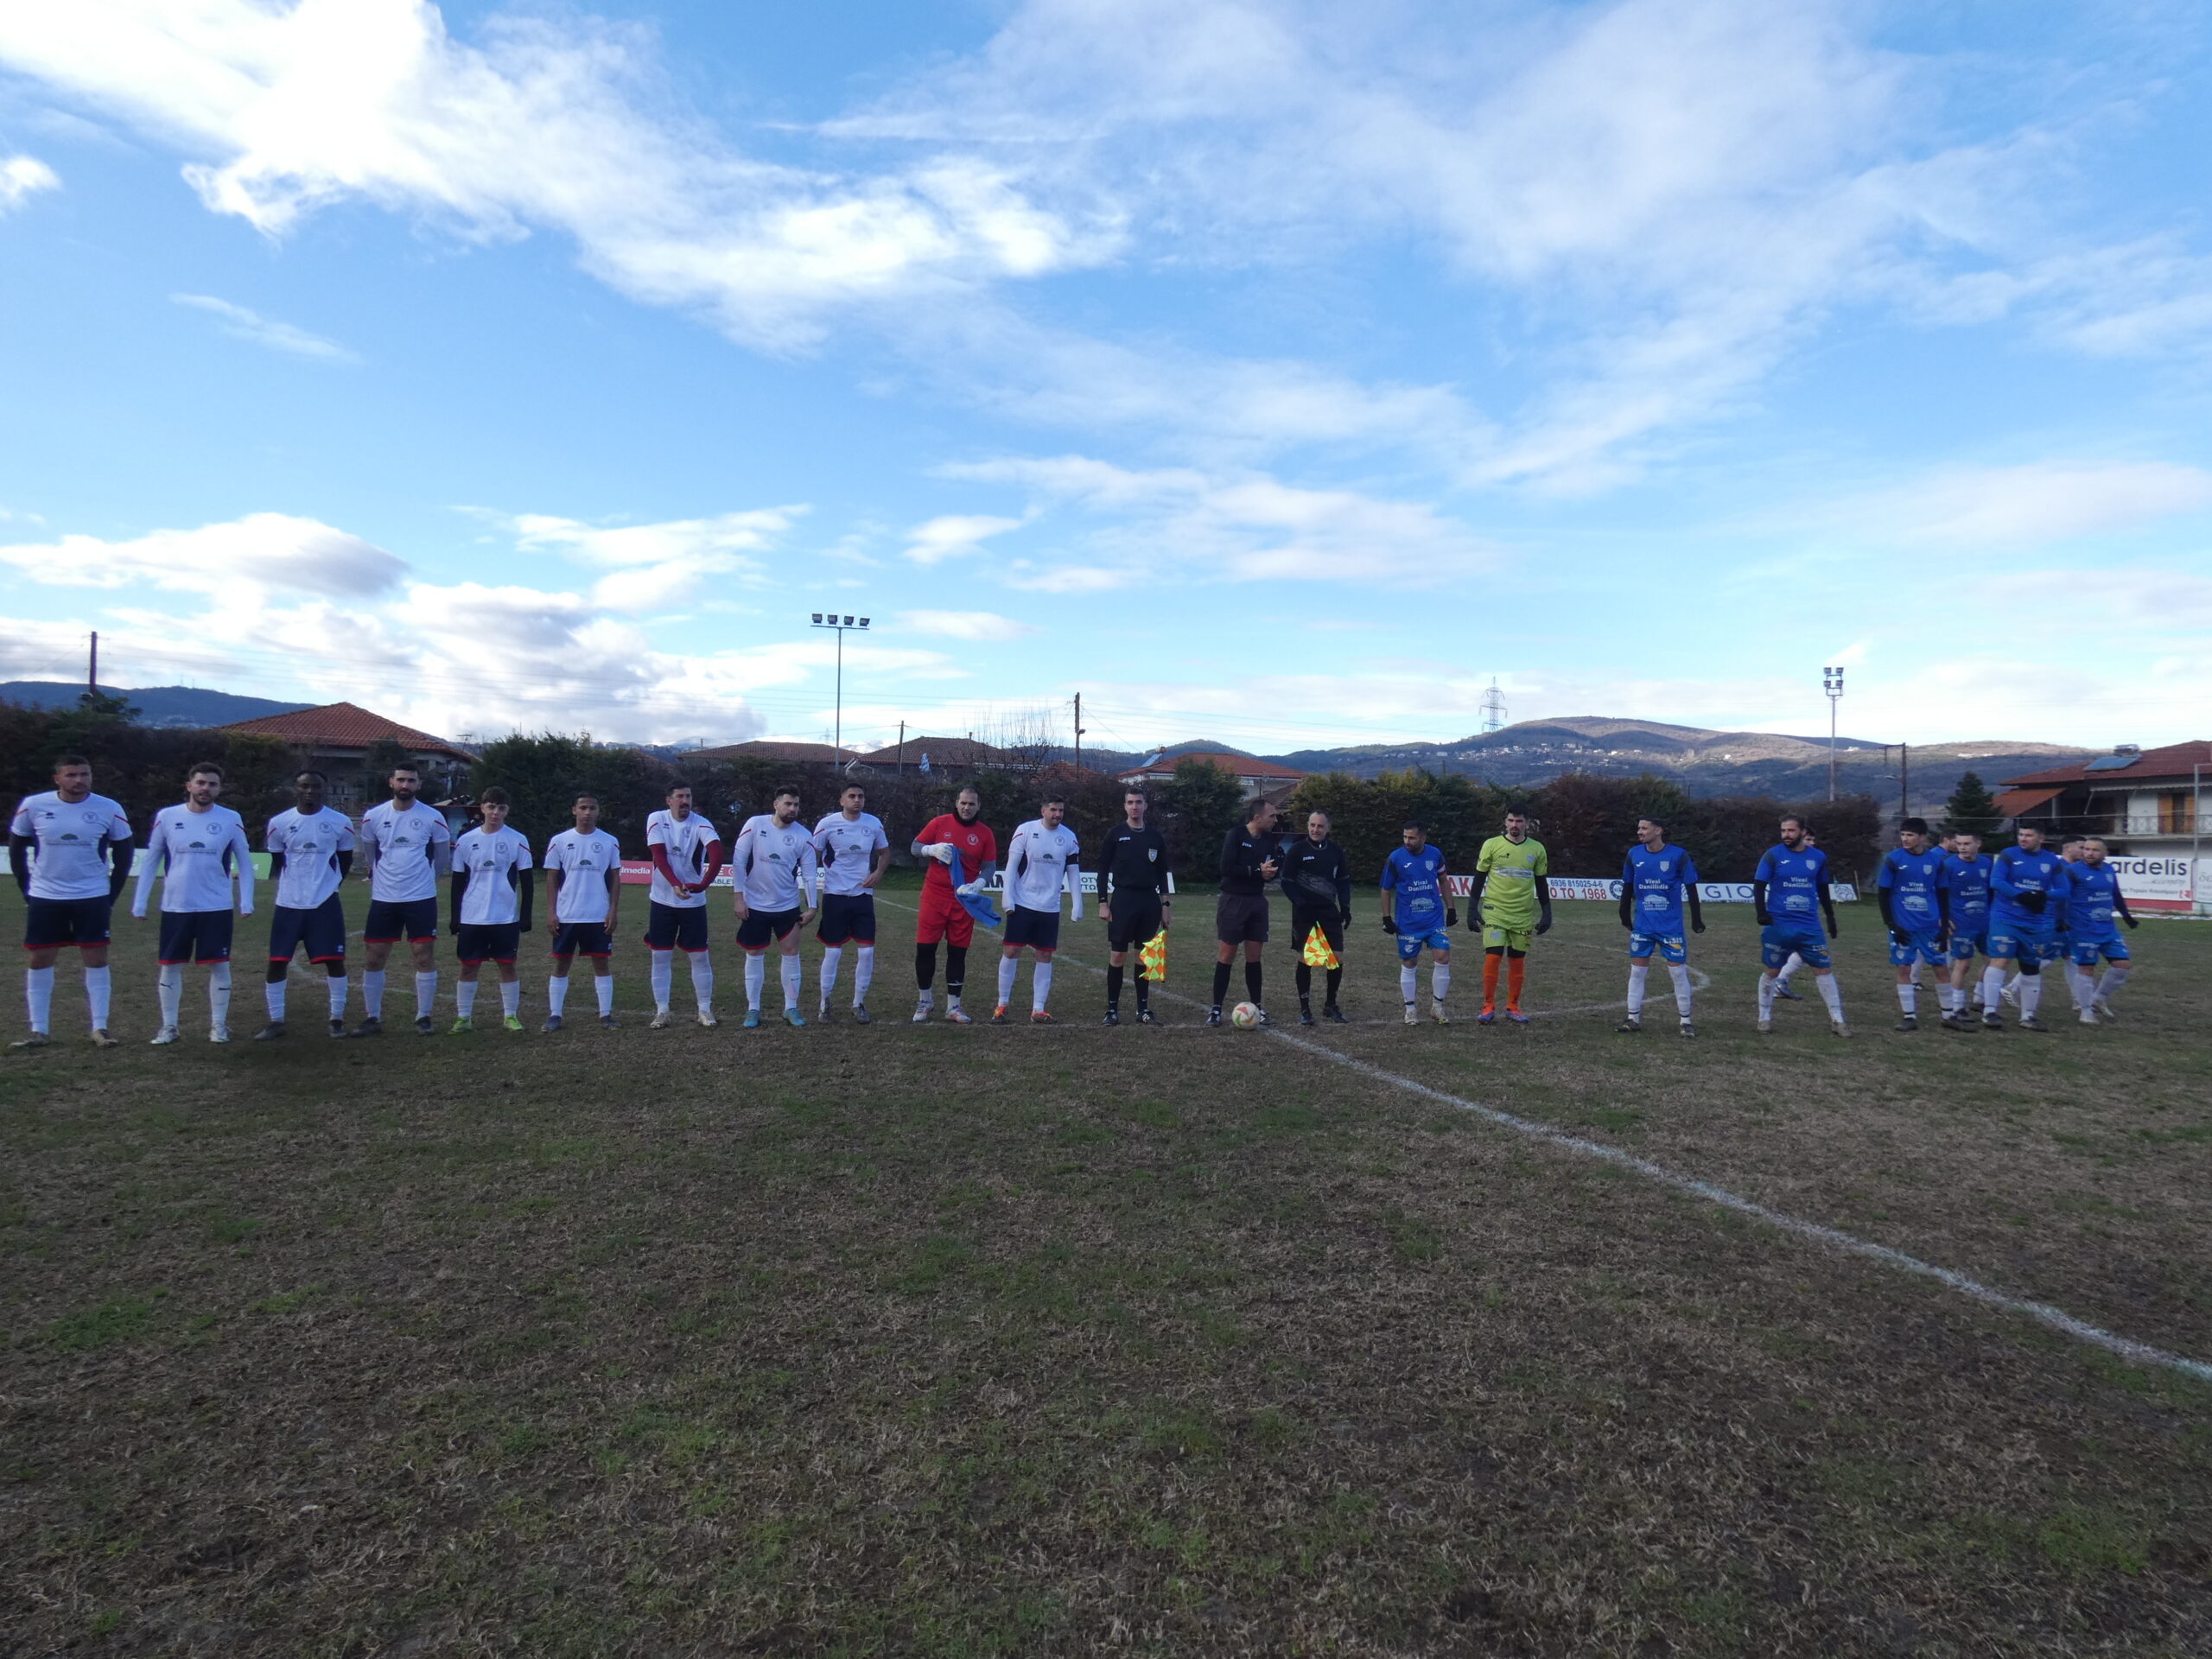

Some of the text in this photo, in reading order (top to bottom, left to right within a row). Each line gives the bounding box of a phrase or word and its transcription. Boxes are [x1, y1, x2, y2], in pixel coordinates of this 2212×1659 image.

[2110, 858, 2188, 876] ardelis
[1581, 888, 1607, 899] 1968
[1705, 885, 1754, 899] GIO
